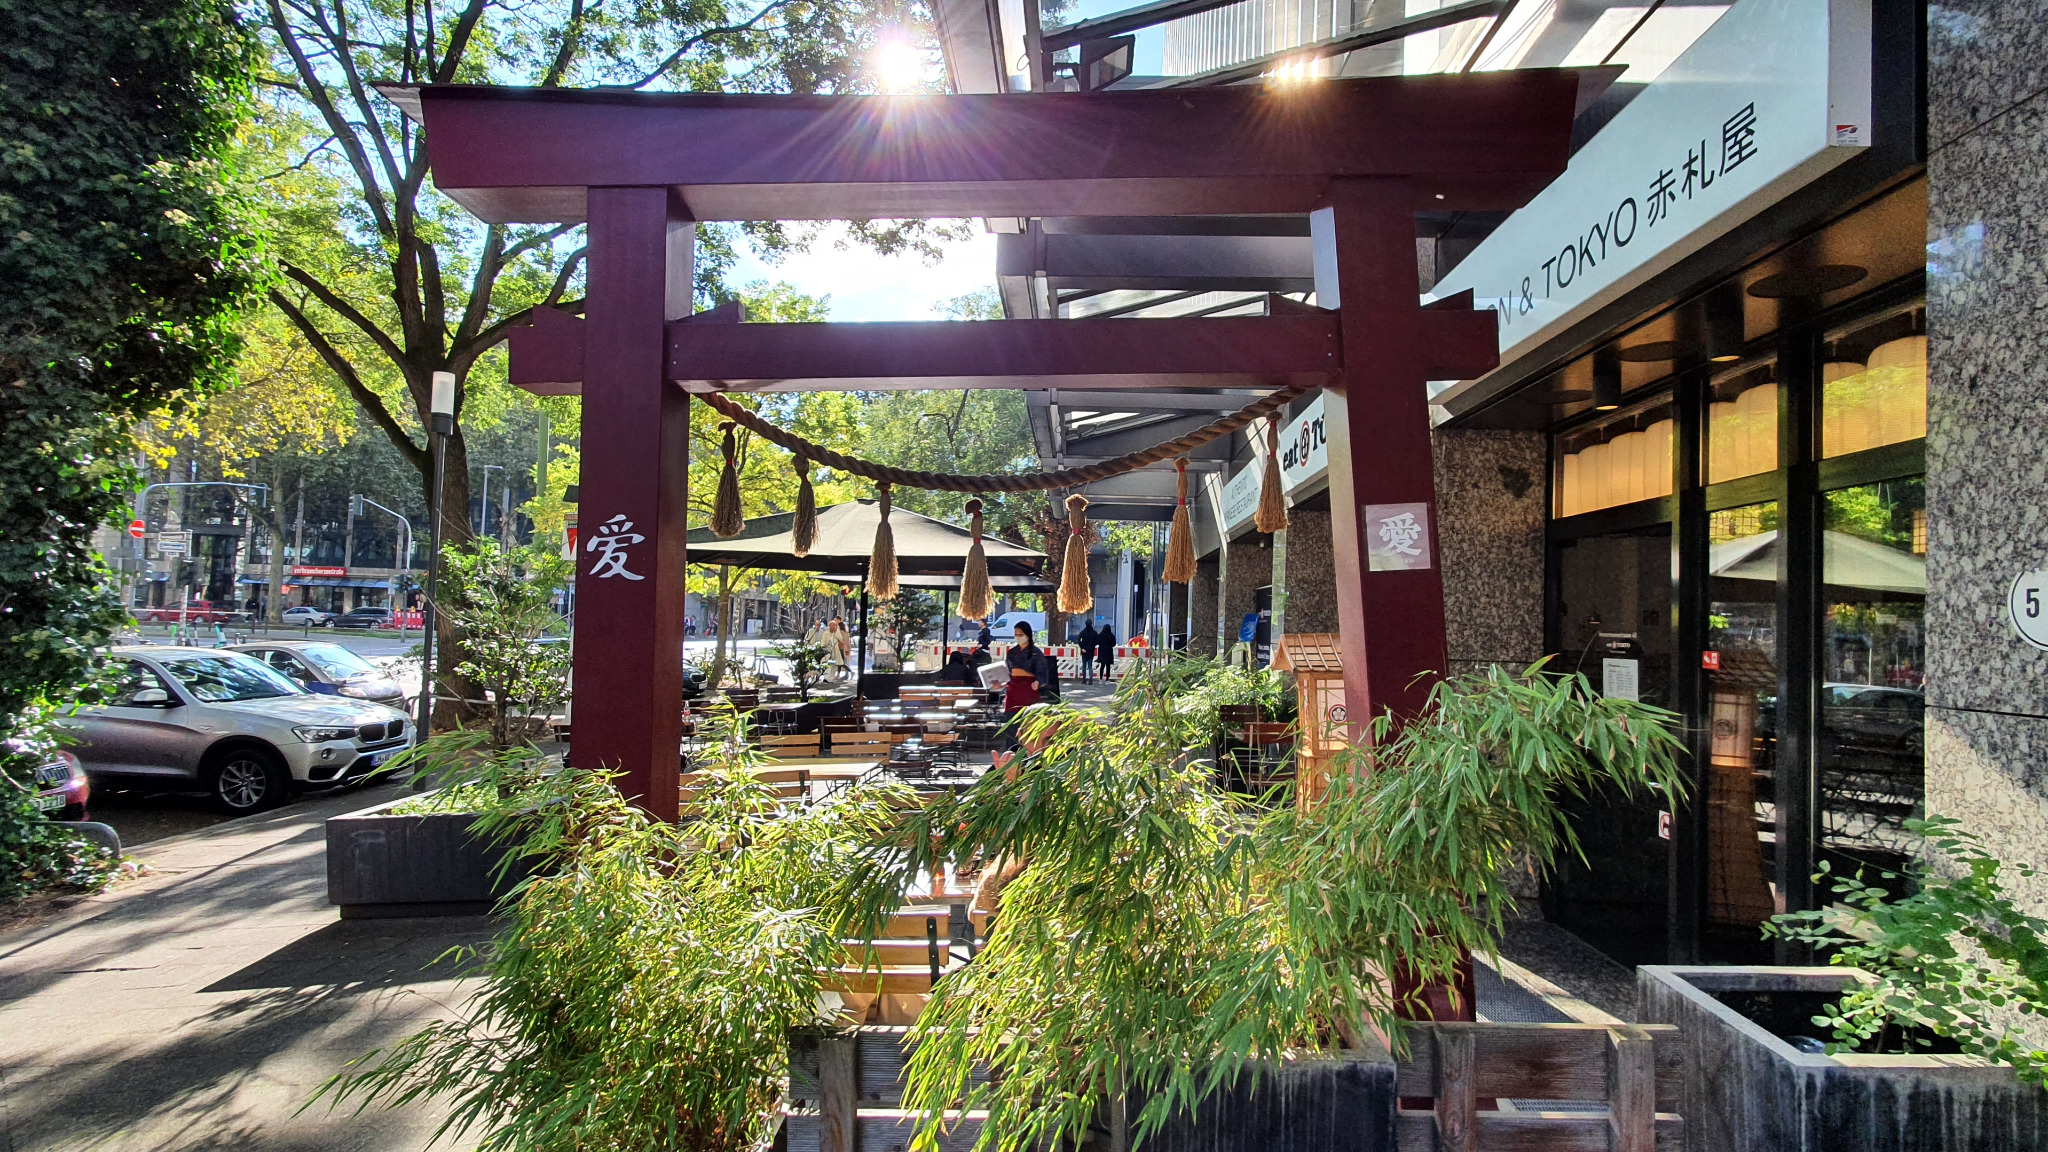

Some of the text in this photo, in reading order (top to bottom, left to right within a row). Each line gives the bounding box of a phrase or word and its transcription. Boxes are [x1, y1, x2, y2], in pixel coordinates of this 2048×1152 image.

[1646, 101, 1758, 228] 赤札屋
[1519, 276, 1534, 316] &
[1541, 197, 1637, 299] TOKYO
[1283, 437, 1299, 472] eat
[586, 513, 646, 581] 爱
[1378, 511, 1423, 556] 愛
